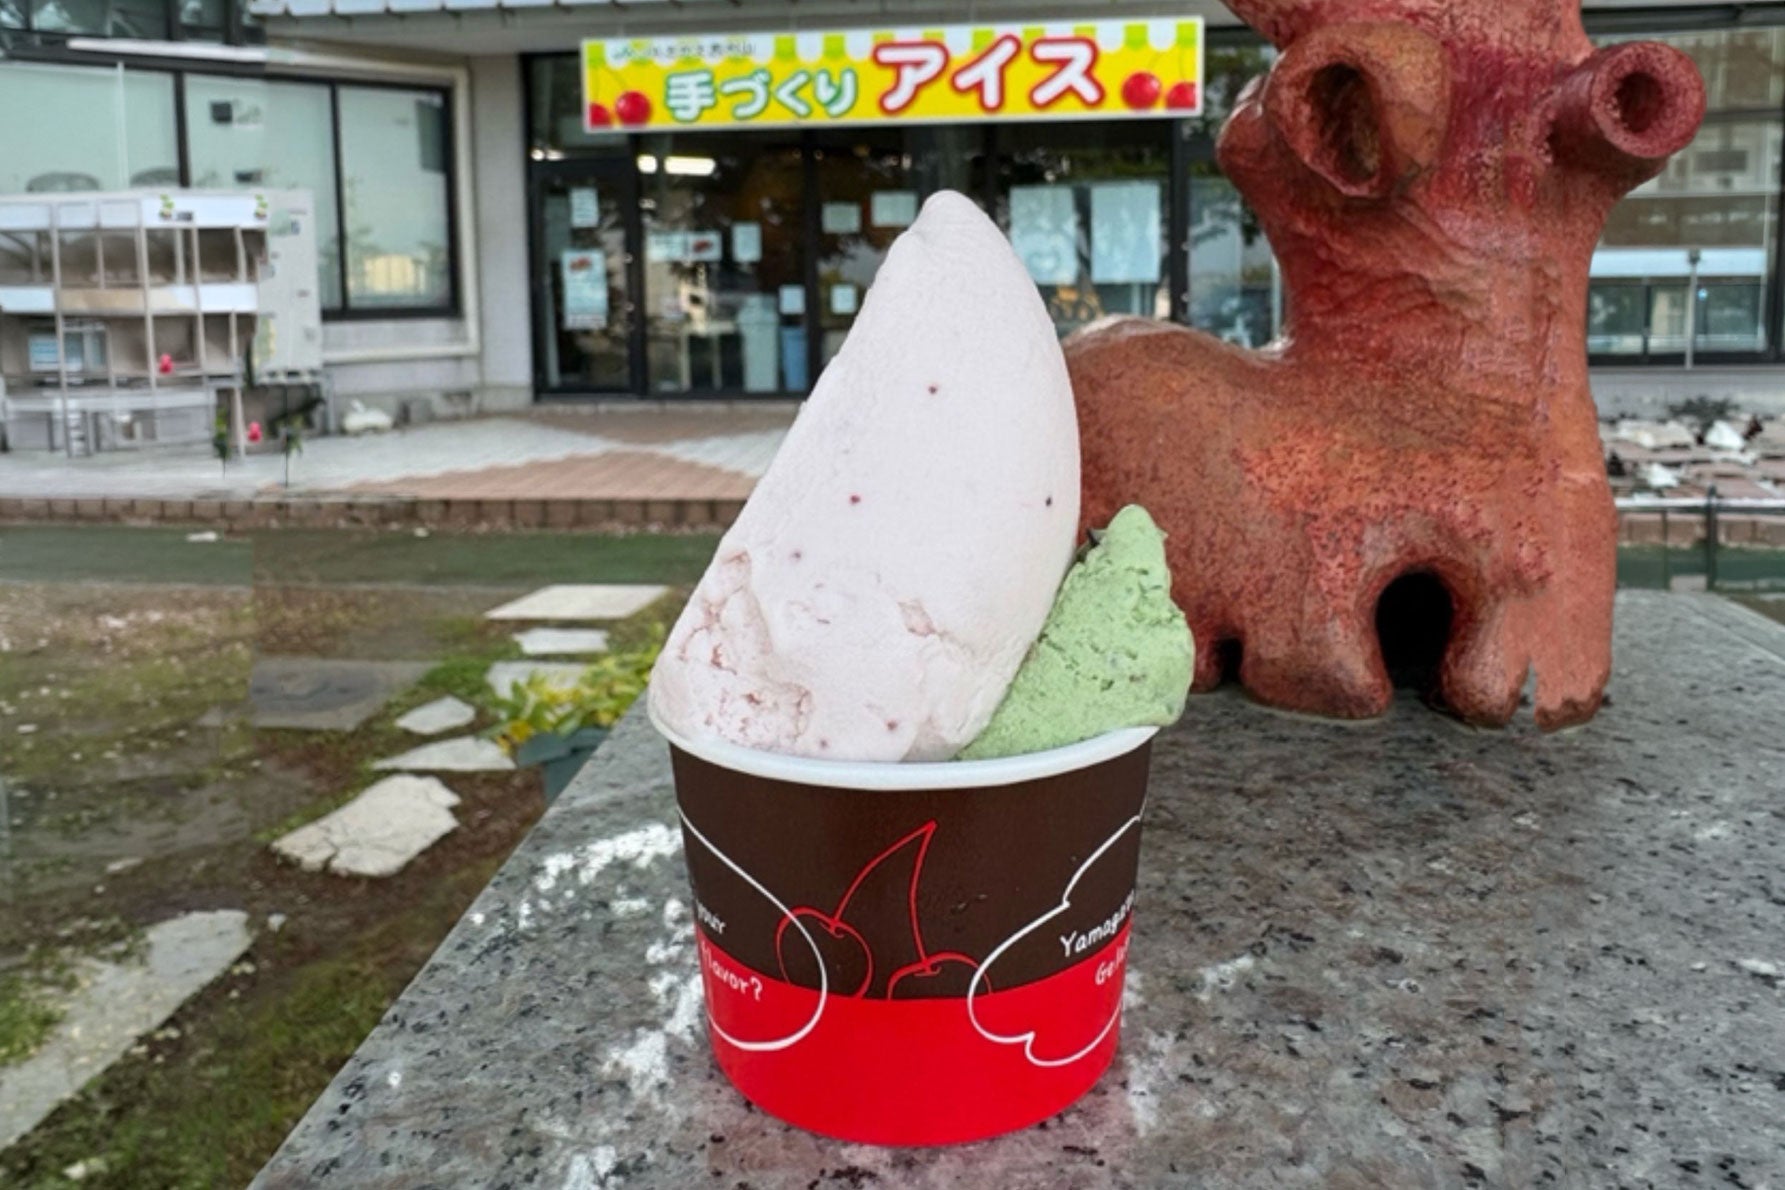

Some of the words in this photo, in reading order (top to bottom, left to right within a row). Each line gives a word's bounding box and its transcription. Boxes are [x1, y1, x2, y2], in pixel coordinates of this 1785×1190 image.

[665, 67, 859, 122] 手づくり
[873, 34, 1106, 113] アイス
